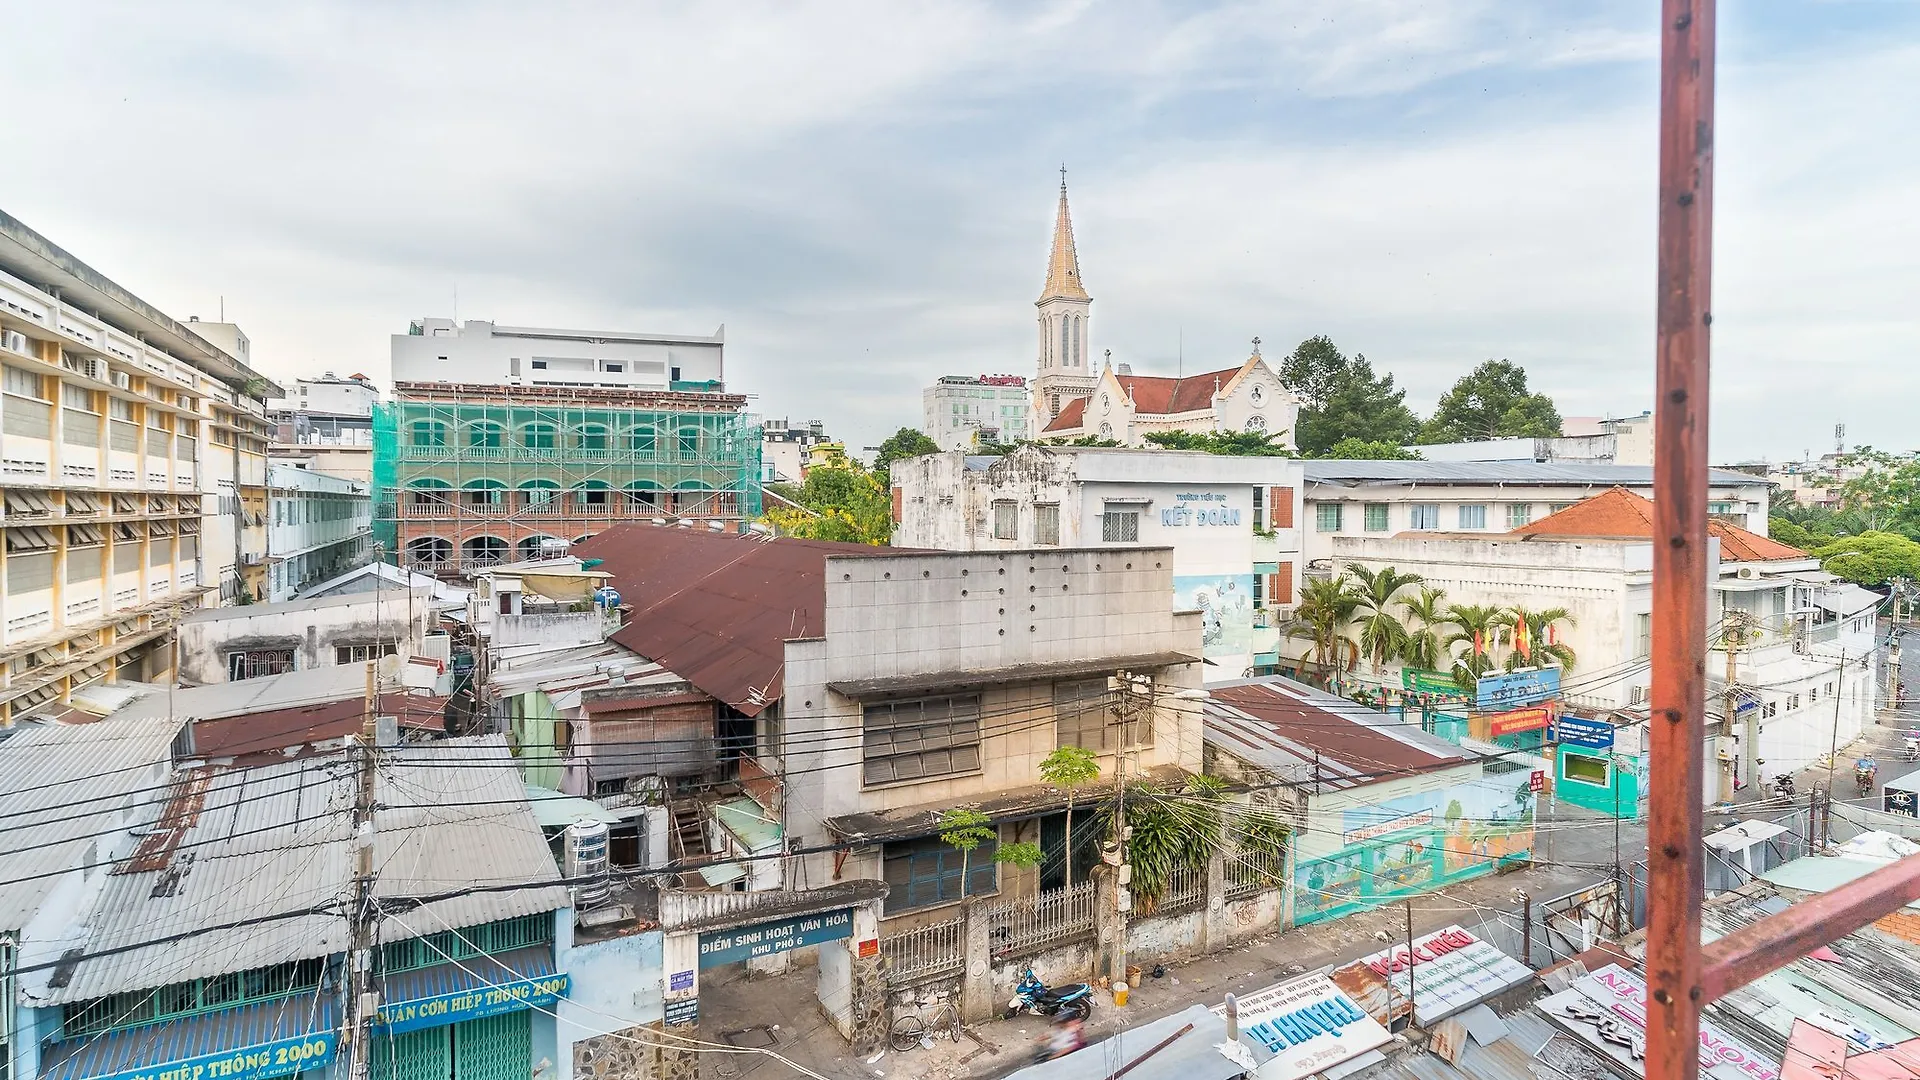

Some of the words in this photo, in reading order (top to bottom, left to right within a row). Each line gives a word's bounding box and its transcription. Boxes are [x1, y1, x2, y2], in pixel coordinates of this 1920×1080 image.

[1161, 502, 1193, 527] KẾT
[1196, 504, 1240, 527] ĐOÀN
[701, 935, 731, 954] ĐIỂM
[735, 932, 762, 947] SINH
[765, 924, 795, 941] HOẠT
[800, 918, 821, 933] VĂN
[826, 913, 849, 926] HÓA
[752, 943, 771, 956] KHU
[775, 937, 795, 951] PHỐ
[797, 937, 803, 946] 6
[375, 1005, 416, 1027] QUÁN
[419, 999, 448, 1018] CƠM
[451, 991, 481, 1012] HIỆP
[486, 984, 530, 1005] THÔNG
[533, 977, 567, 997] 2000
[1311, 988, 1323, 997] 32
[1271, 994, 1366, 1046] THÀNH
[208, 1051, 270, 1078] THÔNG
[275, 1040, 326, 1065] 2000
